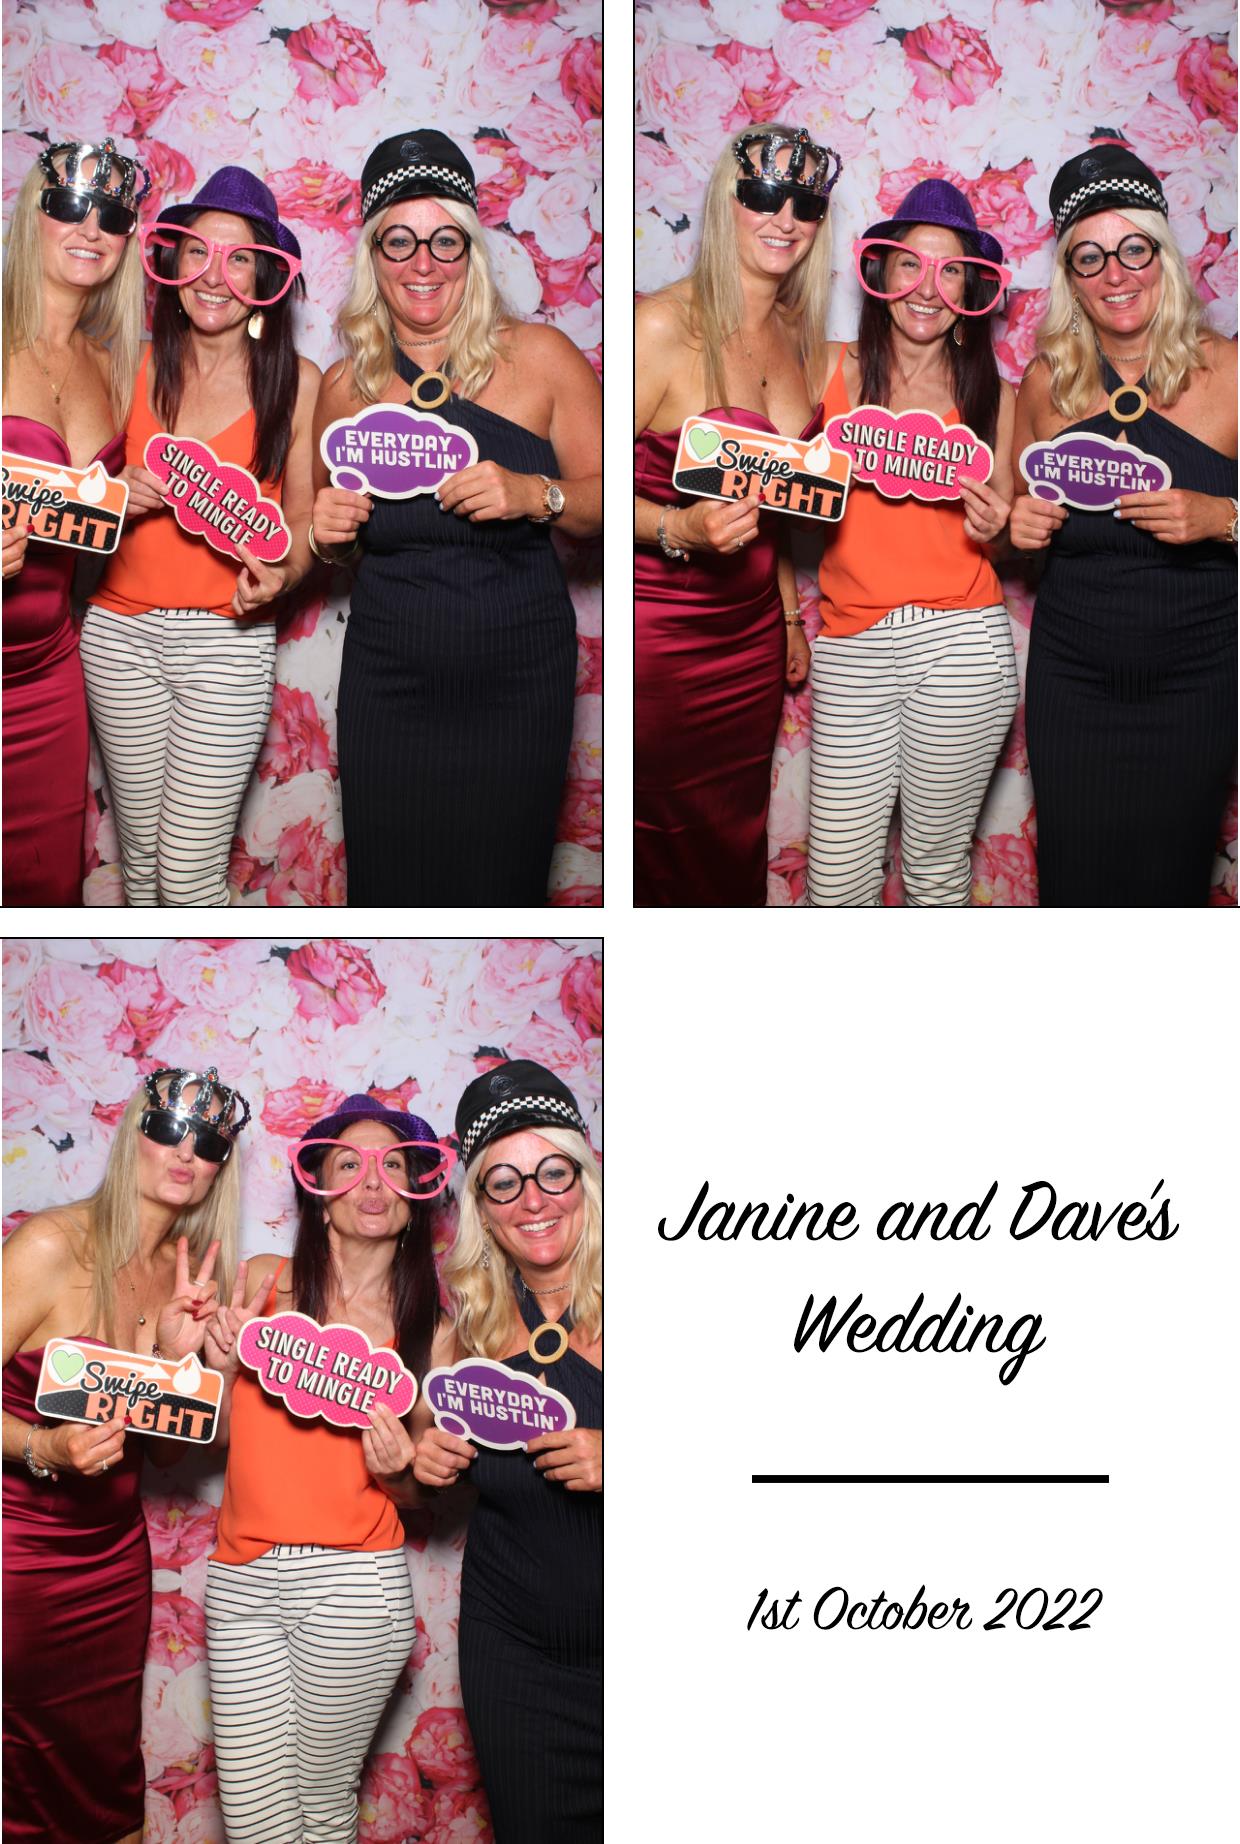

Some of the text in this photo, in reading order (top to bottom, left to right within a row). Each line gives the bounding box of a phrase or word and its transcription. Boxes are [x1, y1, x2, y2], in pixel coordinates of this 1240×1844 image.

[335, 446, 463, 470] I'M HUSTLIN'
[345, 430, 452, 452] EVERYDAY
[840, 422, 979, 466] SINGLE READY
[716, 439, 793, 486] Swipe
[855, 449, 957, 487] TO MINGLE
[1034, 464, 1157, 491] I'M HUSTLIN'
[1043, 451, 1148, 477] EVERYDAY
[160, 443, 282, 542] SINGLE READY
[166, 471, 189, 498] TO
[720, 470, 842, 517] RIGHT
[256, 1326, 404, 1395] SINGLE READY
[81, 1361, 161, 1409] Swipe
[268, 1357, 376, 1414] TO MINGLE
[444, 1379, 547, 1413] EVERYDAY
[85, 1393, 213, 1439] RIGHT
[437, 1393, 559, 1431] I'M HUSTLIN'
